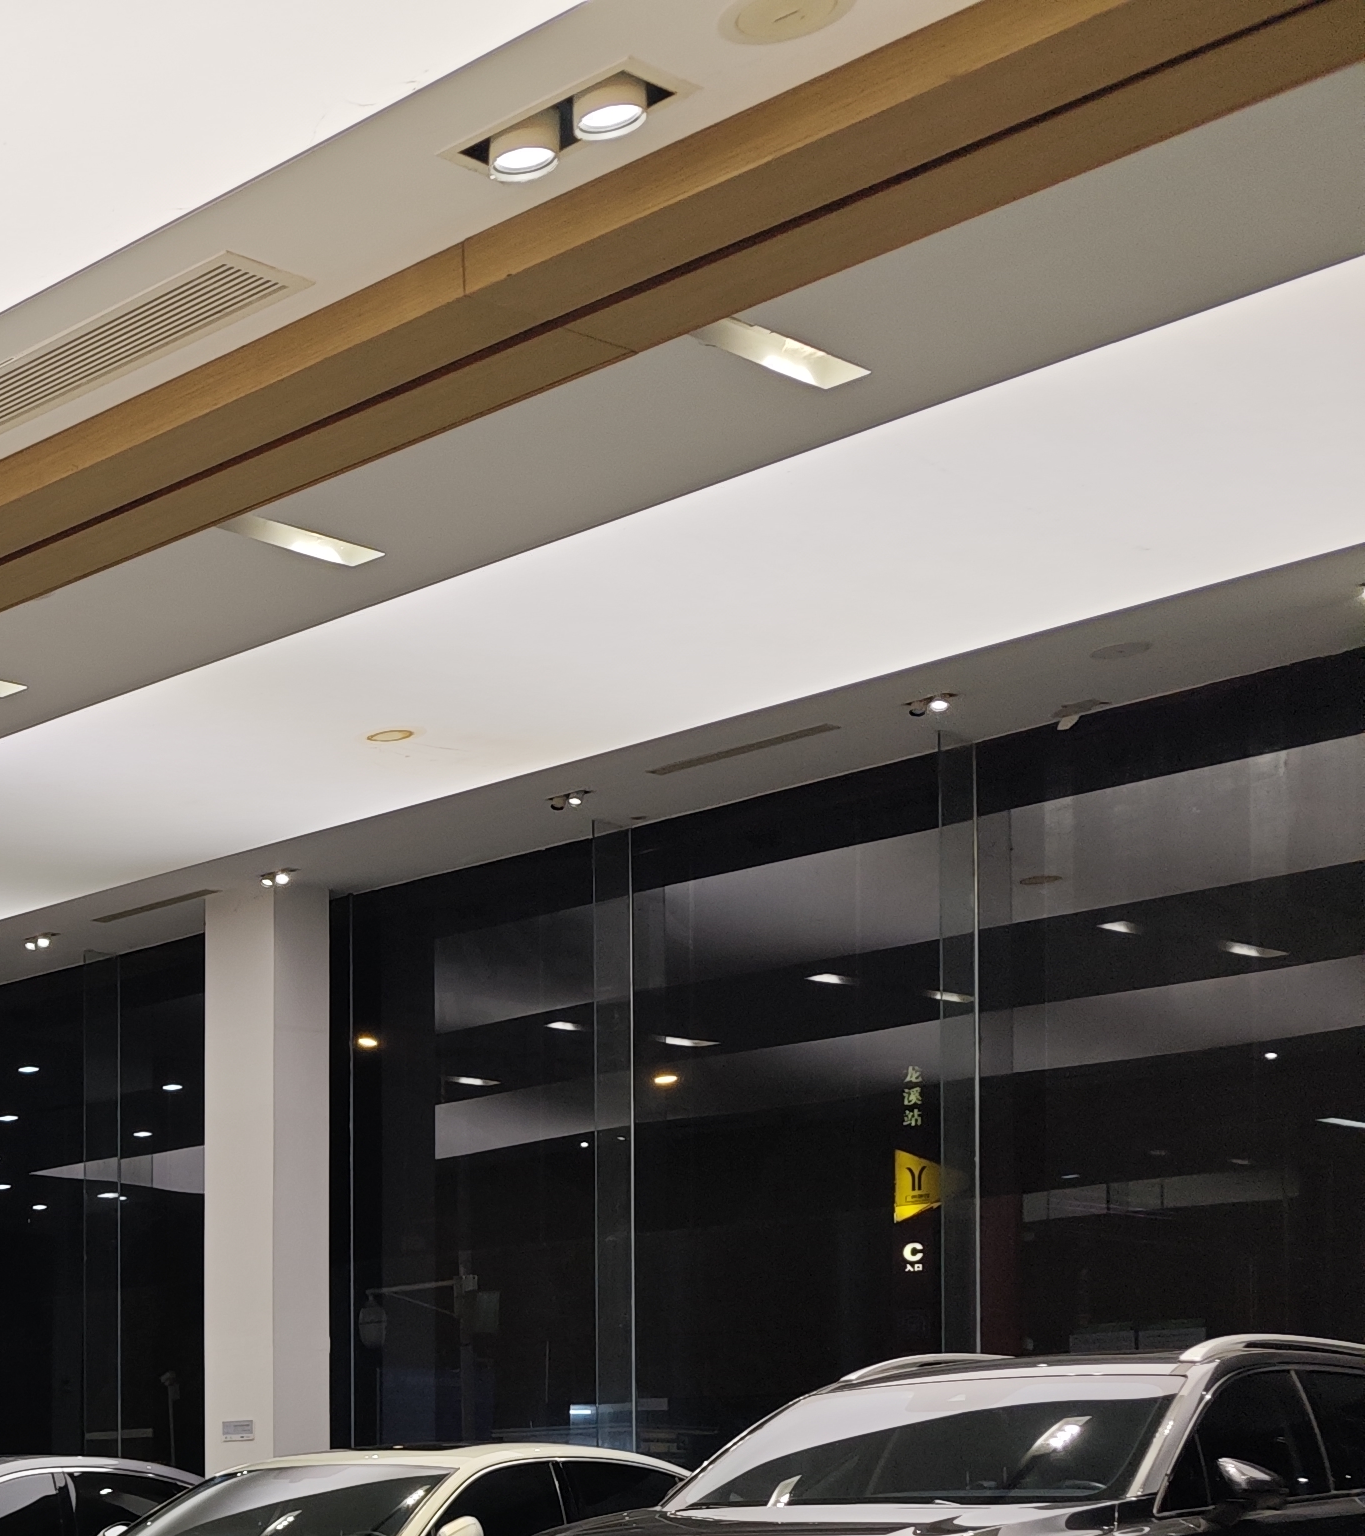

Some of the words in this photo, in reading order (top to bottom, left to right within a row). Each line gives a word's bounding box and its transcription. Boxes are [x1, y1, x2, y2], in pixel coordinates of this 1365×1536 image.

[902, 1065, 923, 1127] 龙溪站
[902, 1242, 924, 1262] C
[904, 1263, 923, 1272] 入口
